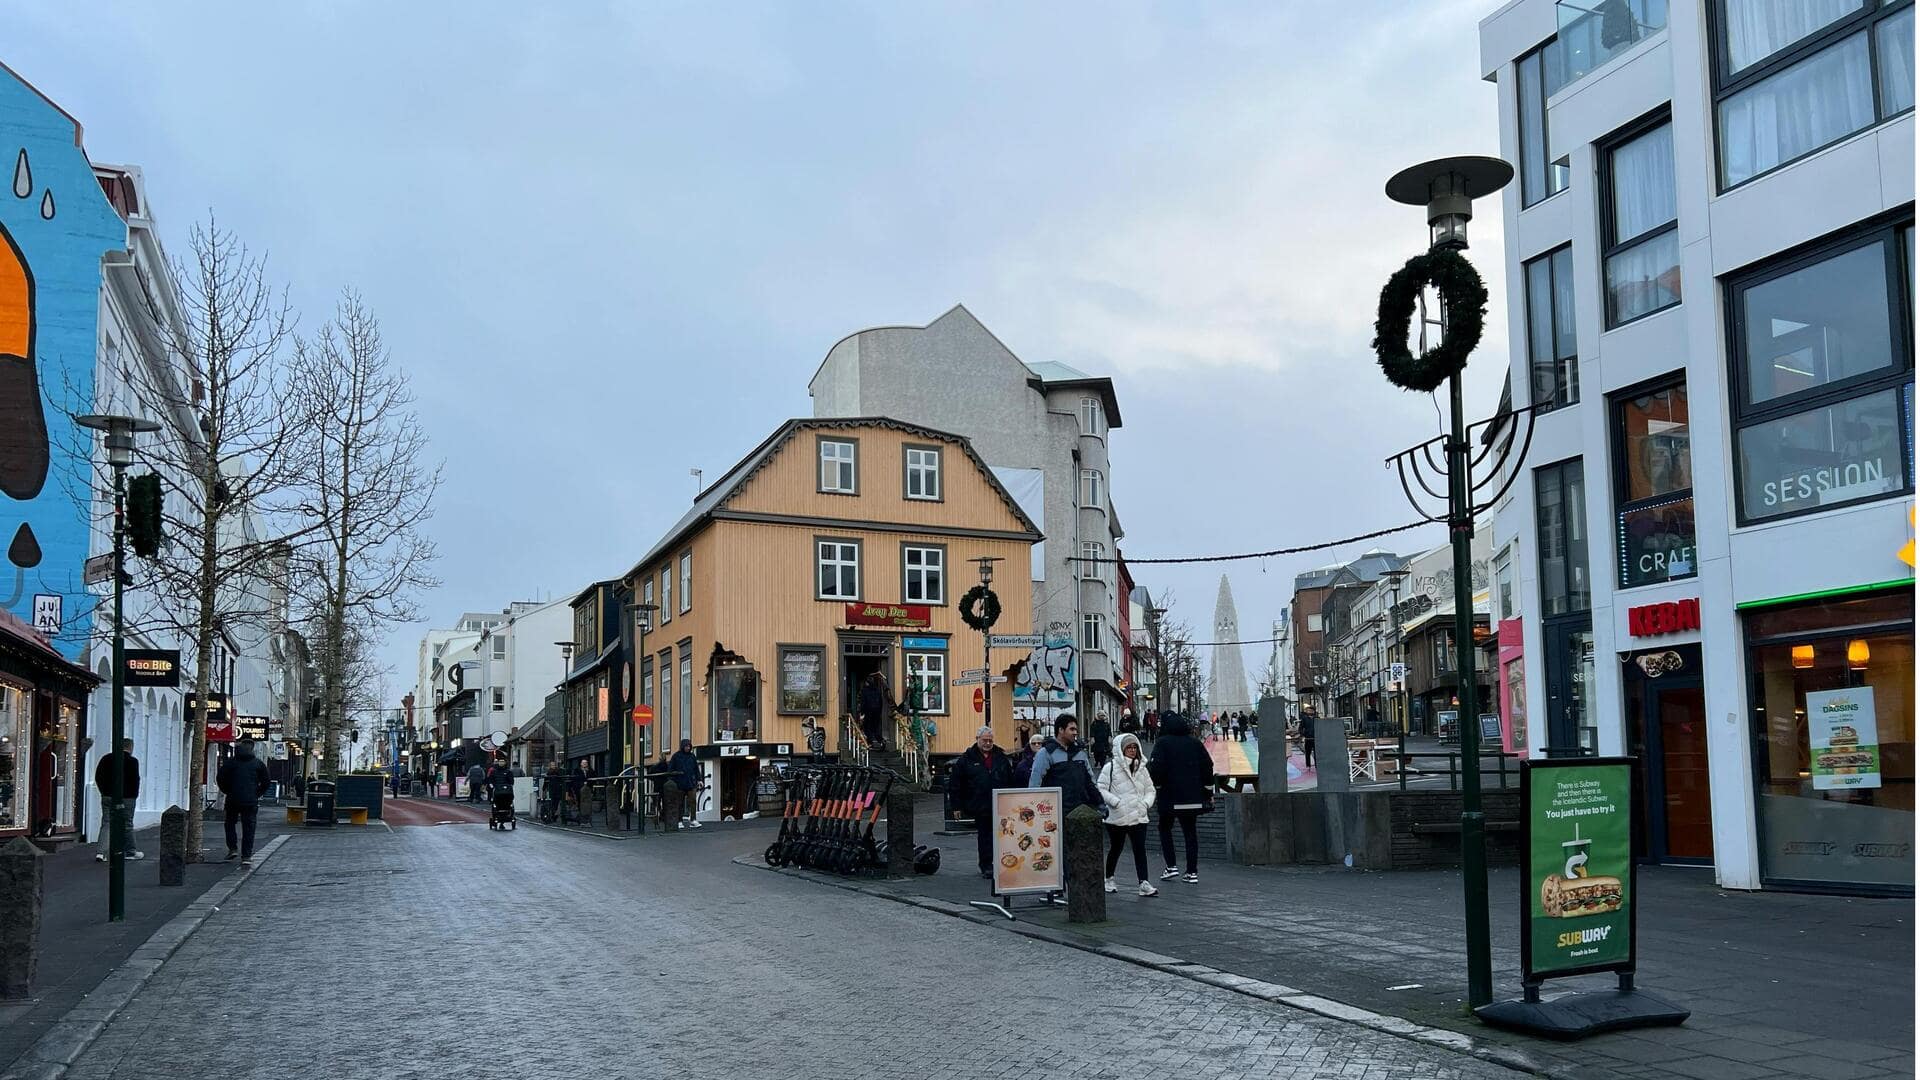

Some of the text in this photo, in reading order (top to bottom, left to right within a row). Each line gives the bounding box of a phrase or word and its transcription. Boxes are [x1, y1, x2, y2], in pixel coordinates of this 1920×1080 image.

[1764, 458, 1884, 506] SESSION
[130, 660, 172, 670] Bao Bite
[1580, 780, 1600, 788] Subway
[1546, 803, 1616, 819] You just have to try it
[1557, 925, 1612, 948] SUBWAY
